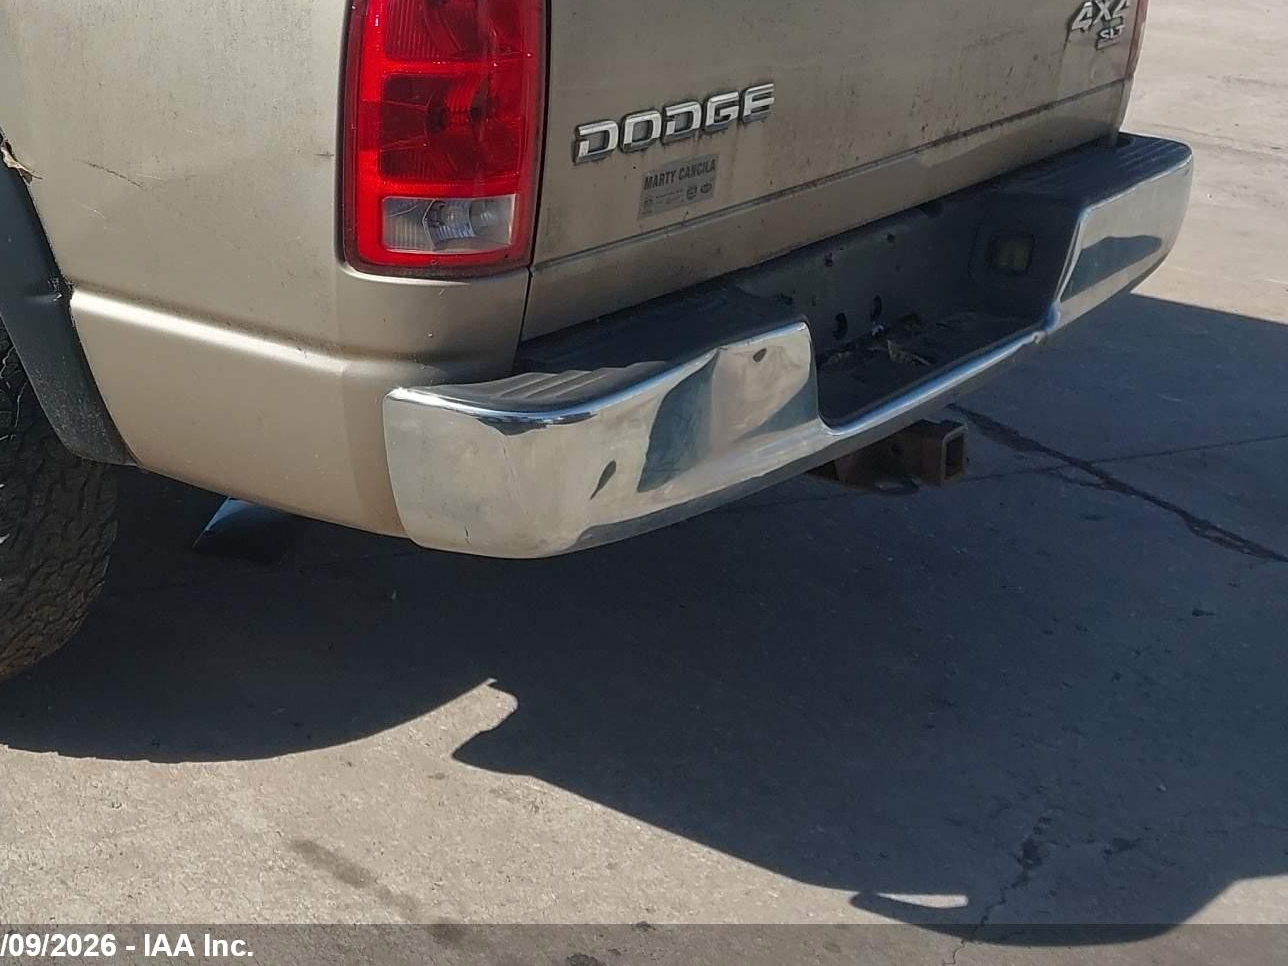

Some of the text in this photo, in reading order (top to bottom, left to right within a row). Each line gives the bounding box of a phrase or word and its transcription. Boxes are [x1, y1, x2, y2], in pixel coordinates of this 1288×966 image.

[1098, 24, 1125, 40] SLT
[573, 82, 775, 165] DODGE
[644, 159, 716, 190] MARTY CANCILA
